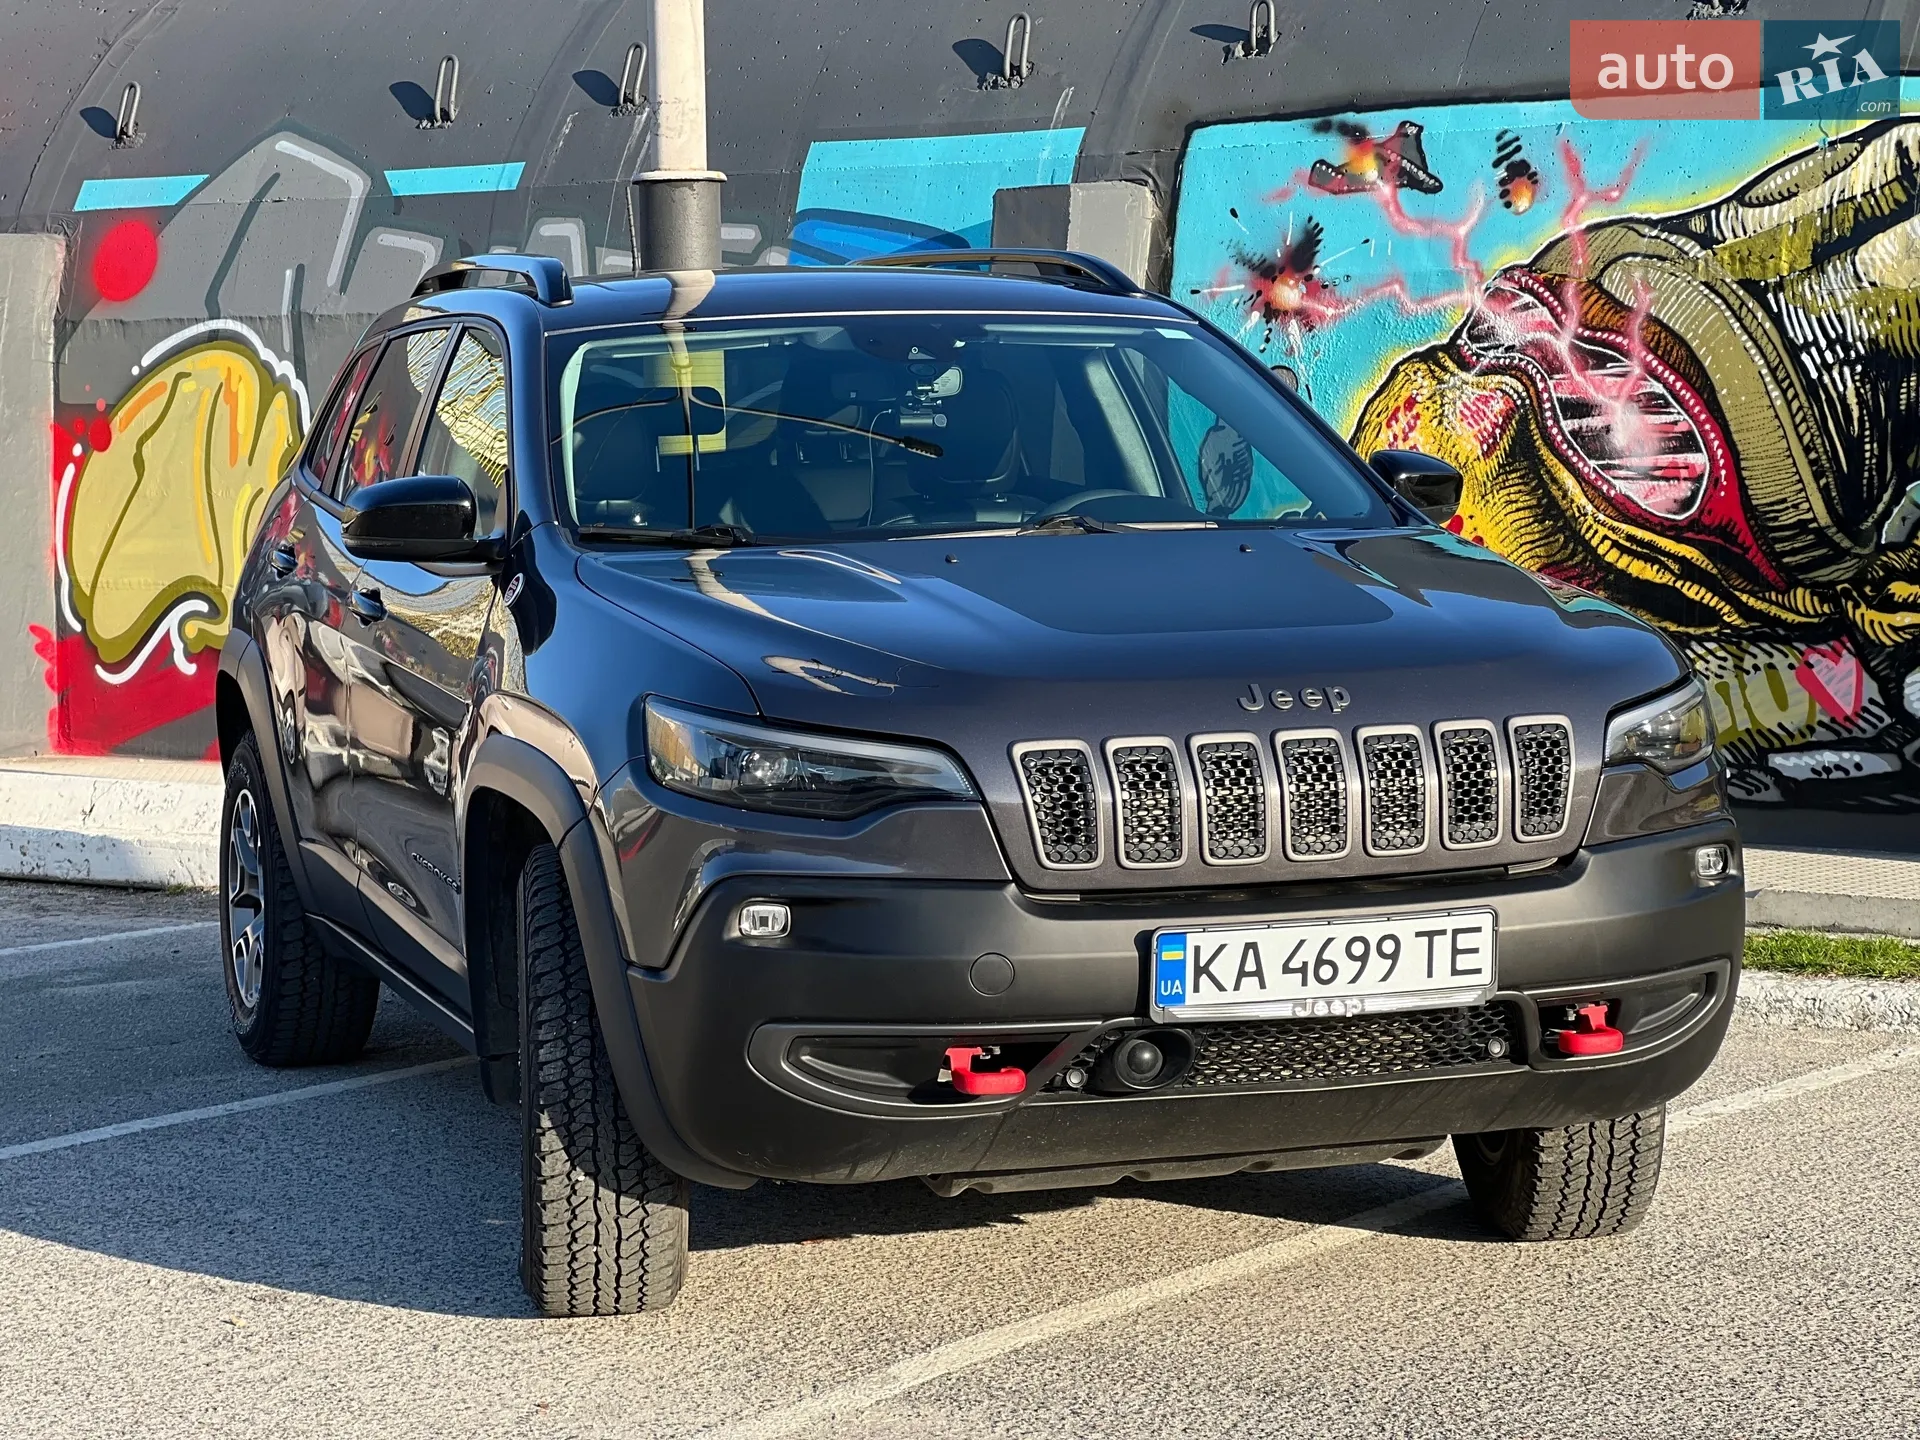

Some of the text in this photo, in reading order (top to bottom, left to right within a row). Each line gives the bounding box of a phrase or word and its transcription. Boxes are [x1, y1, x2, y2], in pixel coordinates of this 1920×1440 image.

[1237, 683, 1351, 715] Jeep
[1160, 926, 1483, 997] UA KA 4699 TE
[1294, 998, 1362, 1018] Jeep
